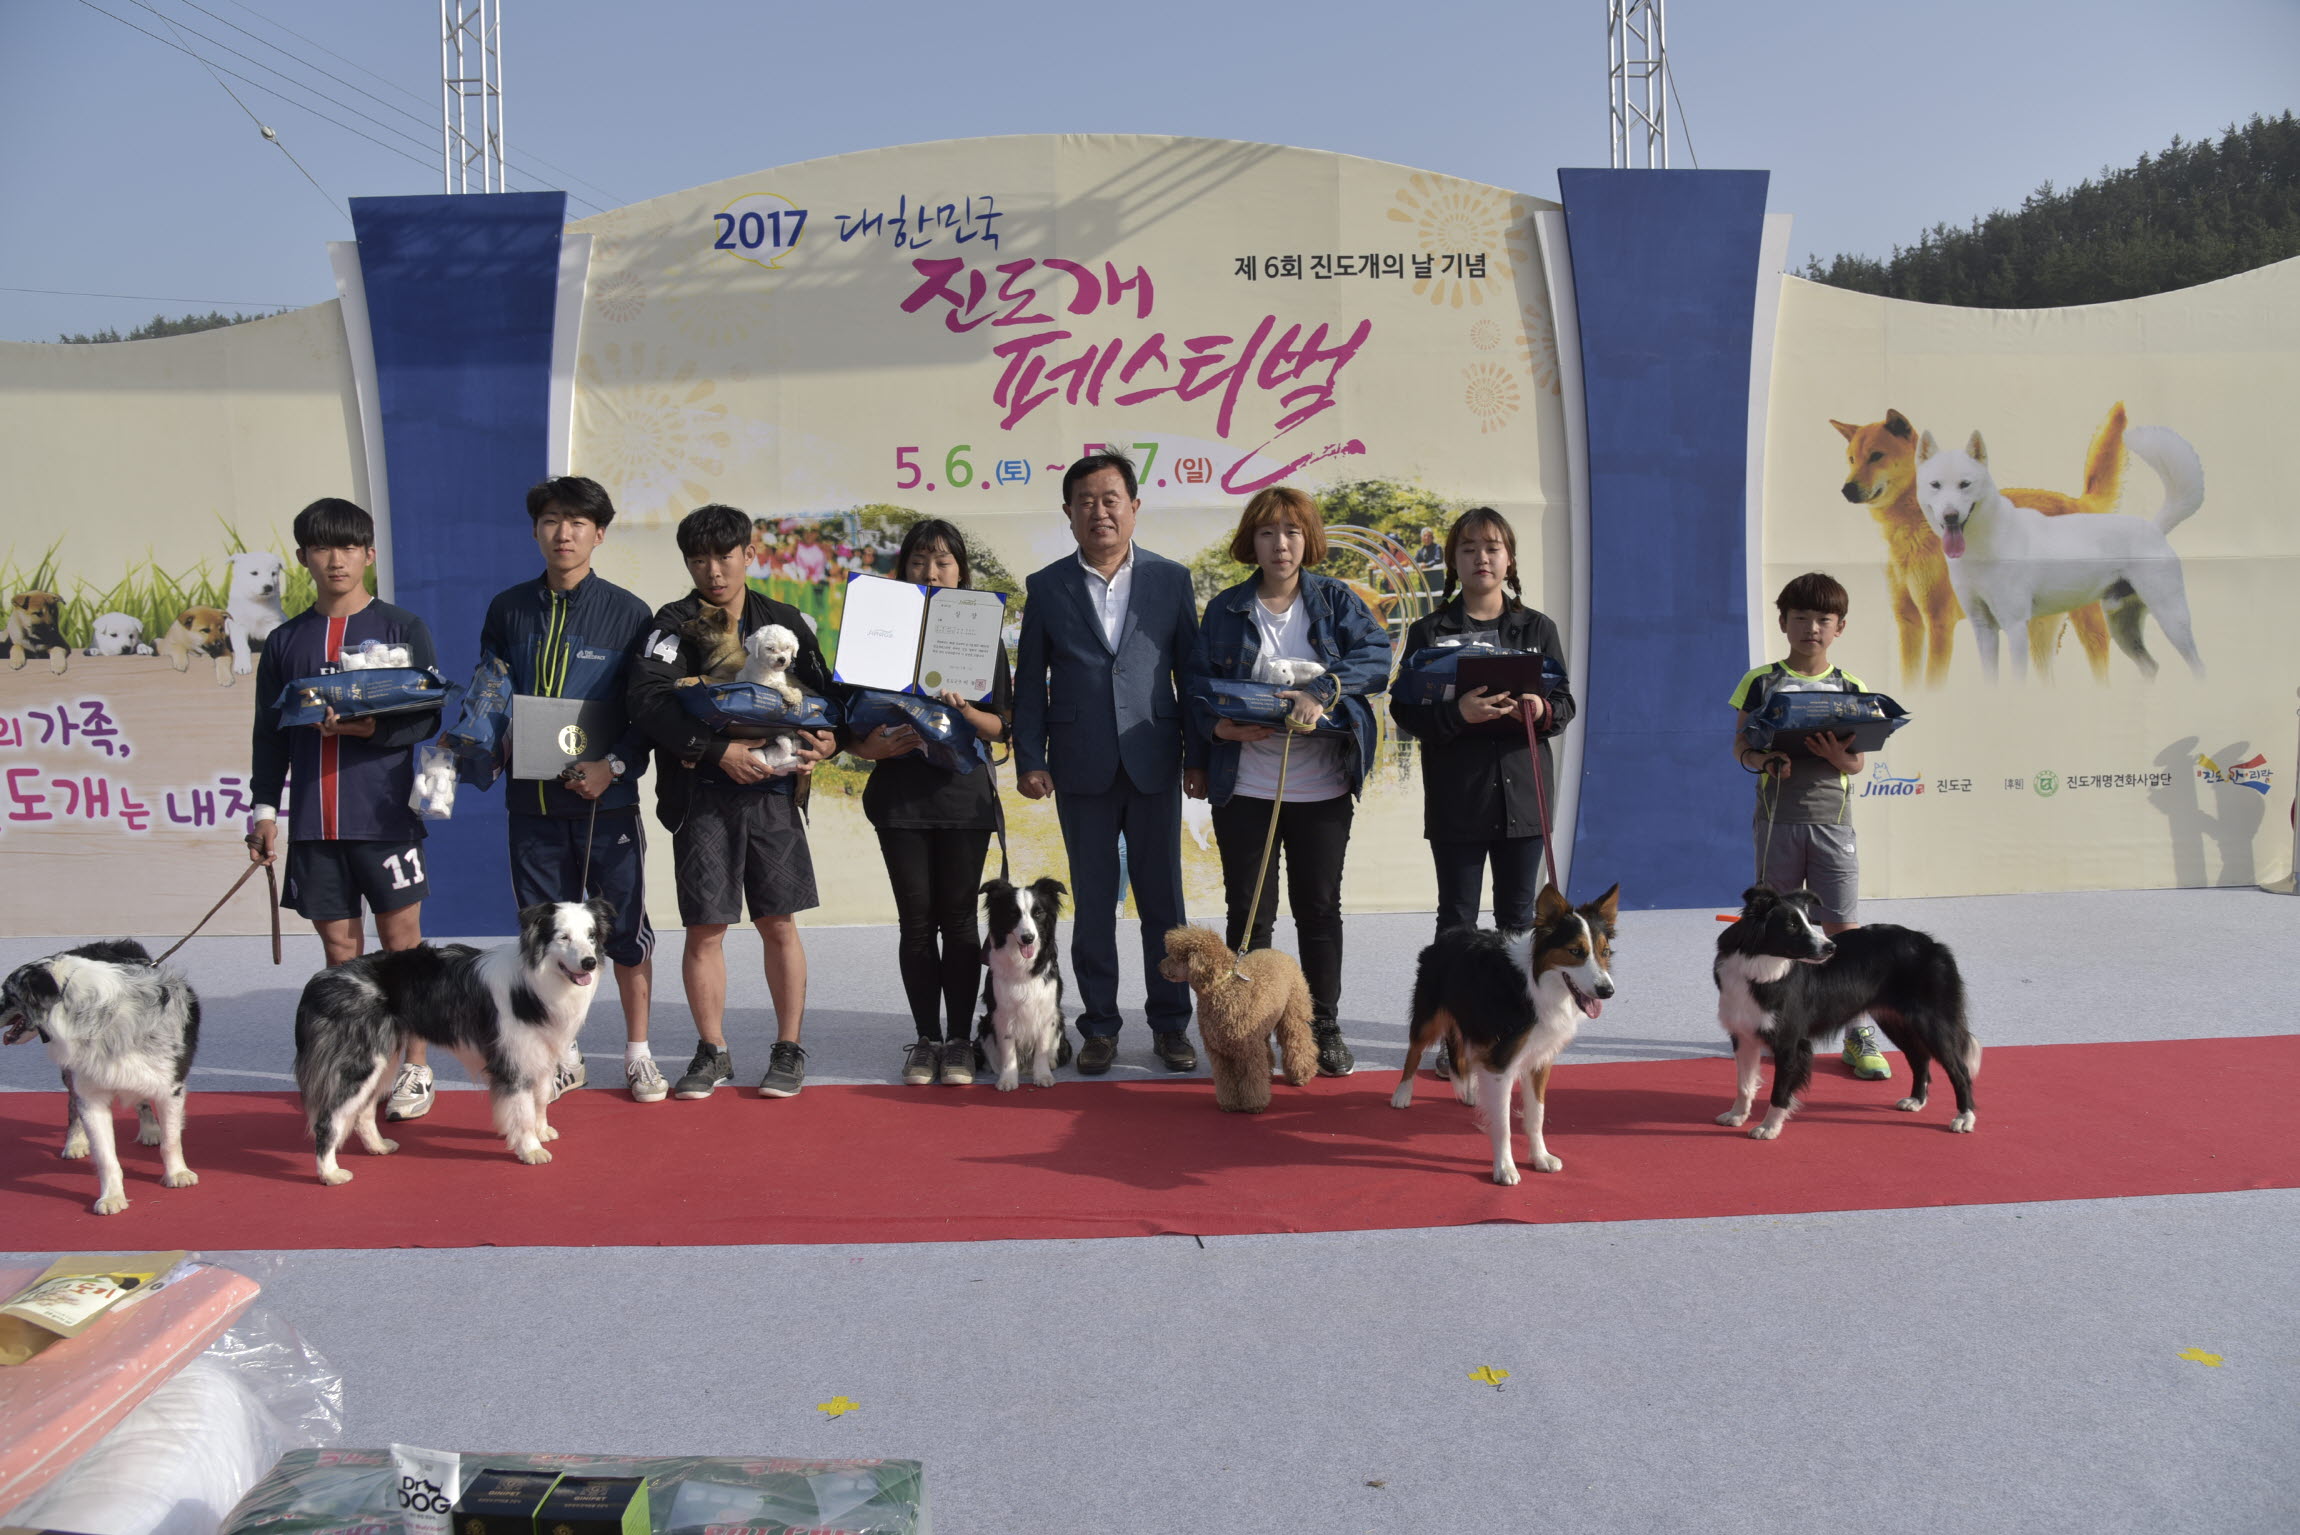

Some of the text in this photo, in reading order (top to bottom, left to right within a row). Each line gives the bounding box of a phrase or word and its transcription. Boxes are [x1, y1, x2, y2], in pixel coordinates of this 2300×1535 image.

[713, 194, 1005, 251] 2017 대한민국
[1234, 252, 1487, 281] 제 6회 진도개의 날 기념
[900, 256, 1155, 334] 진도개
[992, 314, 1371, 494] 페스티벌
[643, 629, 681, 664] 14
[28, 701, 130, 758] 가족,
[0, 769, 150, 831] 도개는
[1860, 781, 1914, 797] Jindo
[1937, 779, 1972, 793] 진도군
[2066, 772, 2172, 790] 진도개명견화사업단
[382, 848, 425, 890] 11
[396, 1489, 452, 1514] DOG
[403, 1476, 422, 1491] Dr
